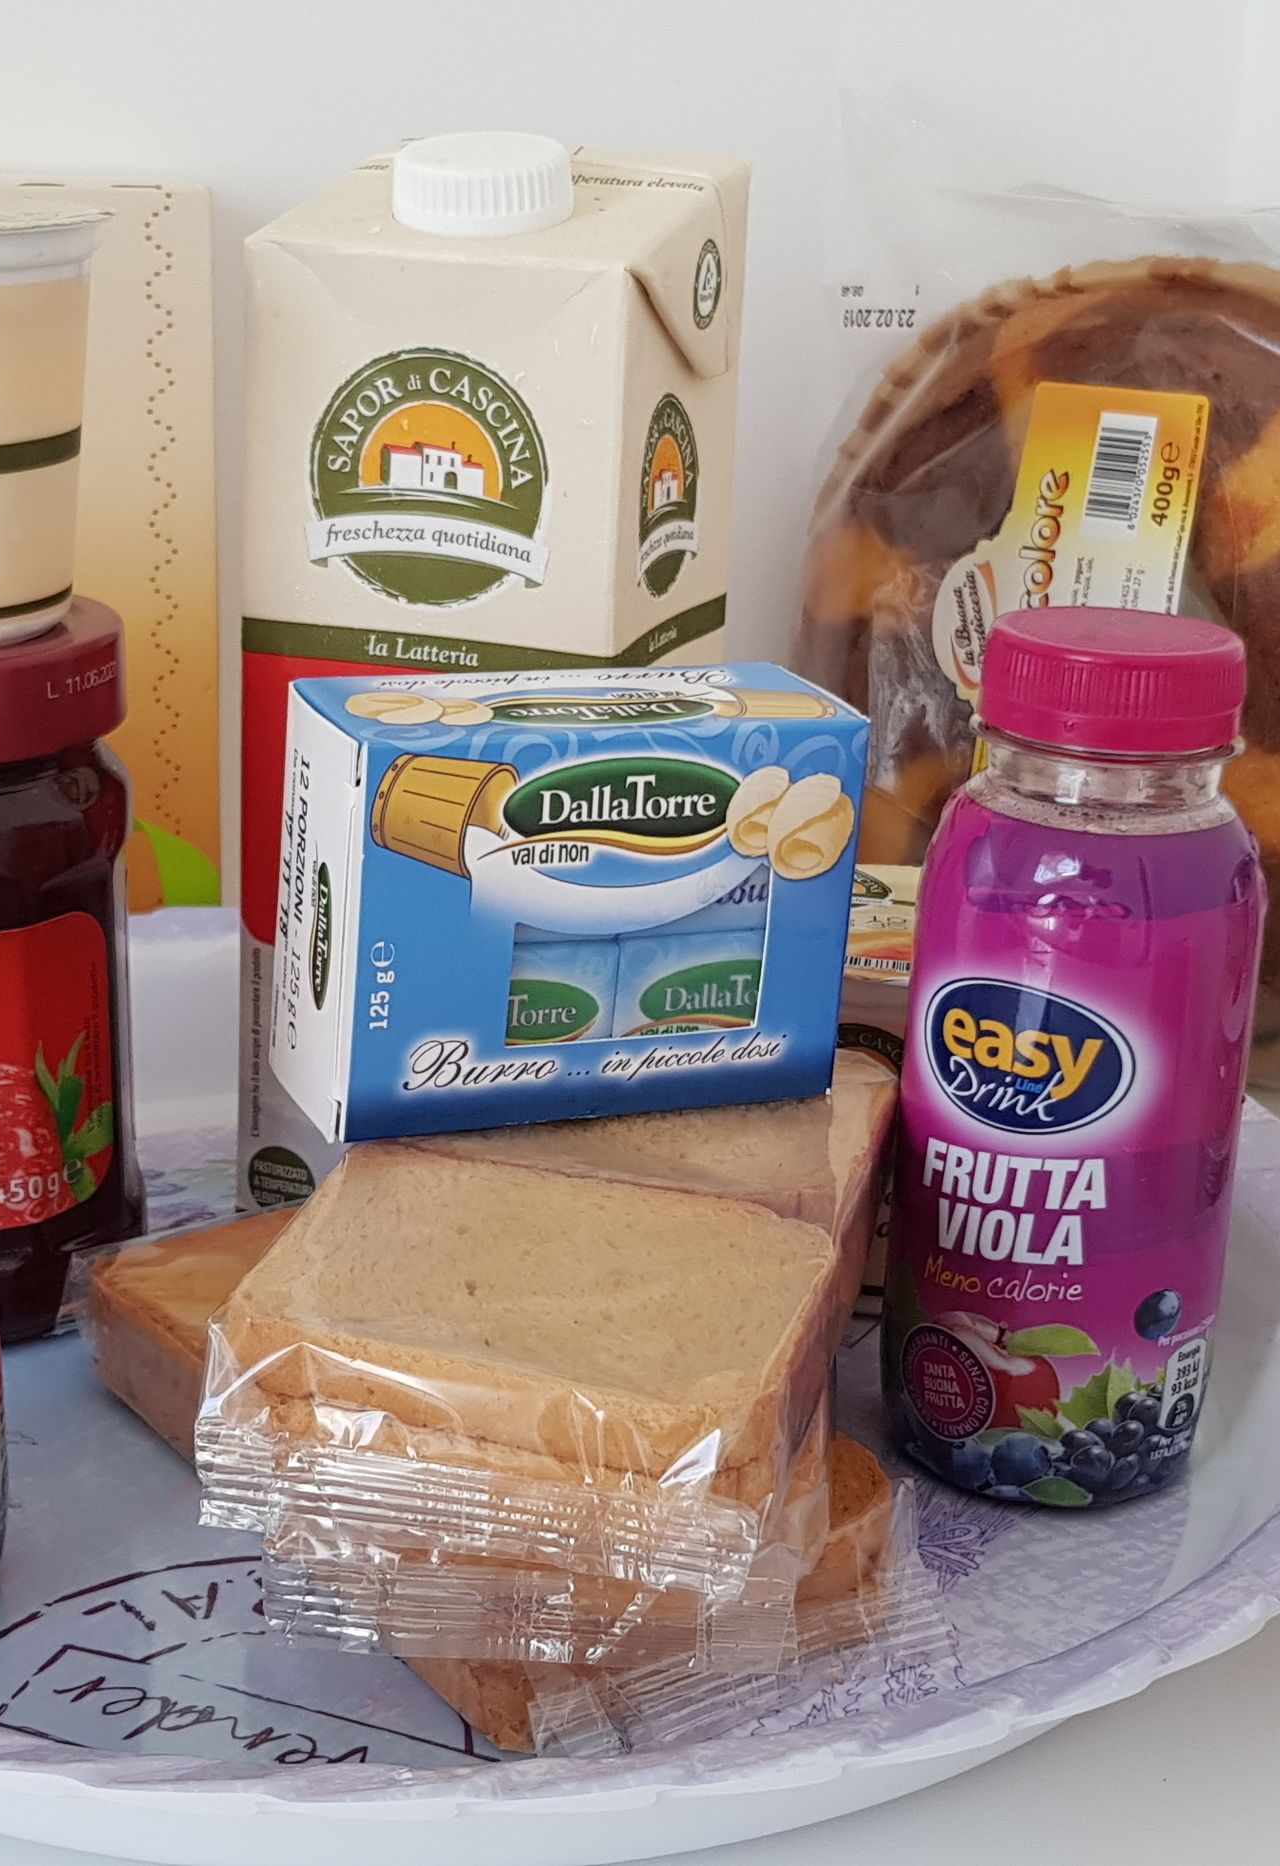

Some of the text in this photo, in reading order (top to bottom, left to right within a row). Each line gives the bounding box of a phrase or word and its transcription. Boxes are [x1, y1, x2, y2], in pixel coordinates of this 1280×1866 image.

[842, 309, 916, 328] 23.02.2019
[327, 376, 402, 473] SAPOR
[407, 375, 422, 391] di
[429, 368, 533, 489] CASCINA
[1150, 467, 1180, 528] 400g
[325, 520, 531, 563] freschezza quotidiana
[953, 586, 972, 650] Buona
[368, 634, 479, 667] la Latteria
[46, 681, 60, 700] L
[510, 700, 688, 721] DallaTorre
[298, 754, 311, 790] 12
[538, 773, 716, 828] DallaTorre
[293, 797, 309, 923] PORZIONI
[511, 843, 590, 868] val di non
[369, 985, 388, 1030] 125
[402, 1032, 789, 1091] Burro in piccole dosi
[941, 1007, 1104, 1102] easy
[946, 1055, 1063, 1123] Drink Line
[922, 1136, 1107, 1210] FRUTTA
[937, 1197, 1084, 1266] VIOLA
[923, 1254, 1084, 1302] Meno calorie
[922, 1361, 957, 1380] TANTA
[923, 1375, 961, 1396] BUONA
[958, 1351, 987, 1393] SENZA
[924, 1389, 966, 1411] FRUTTA
